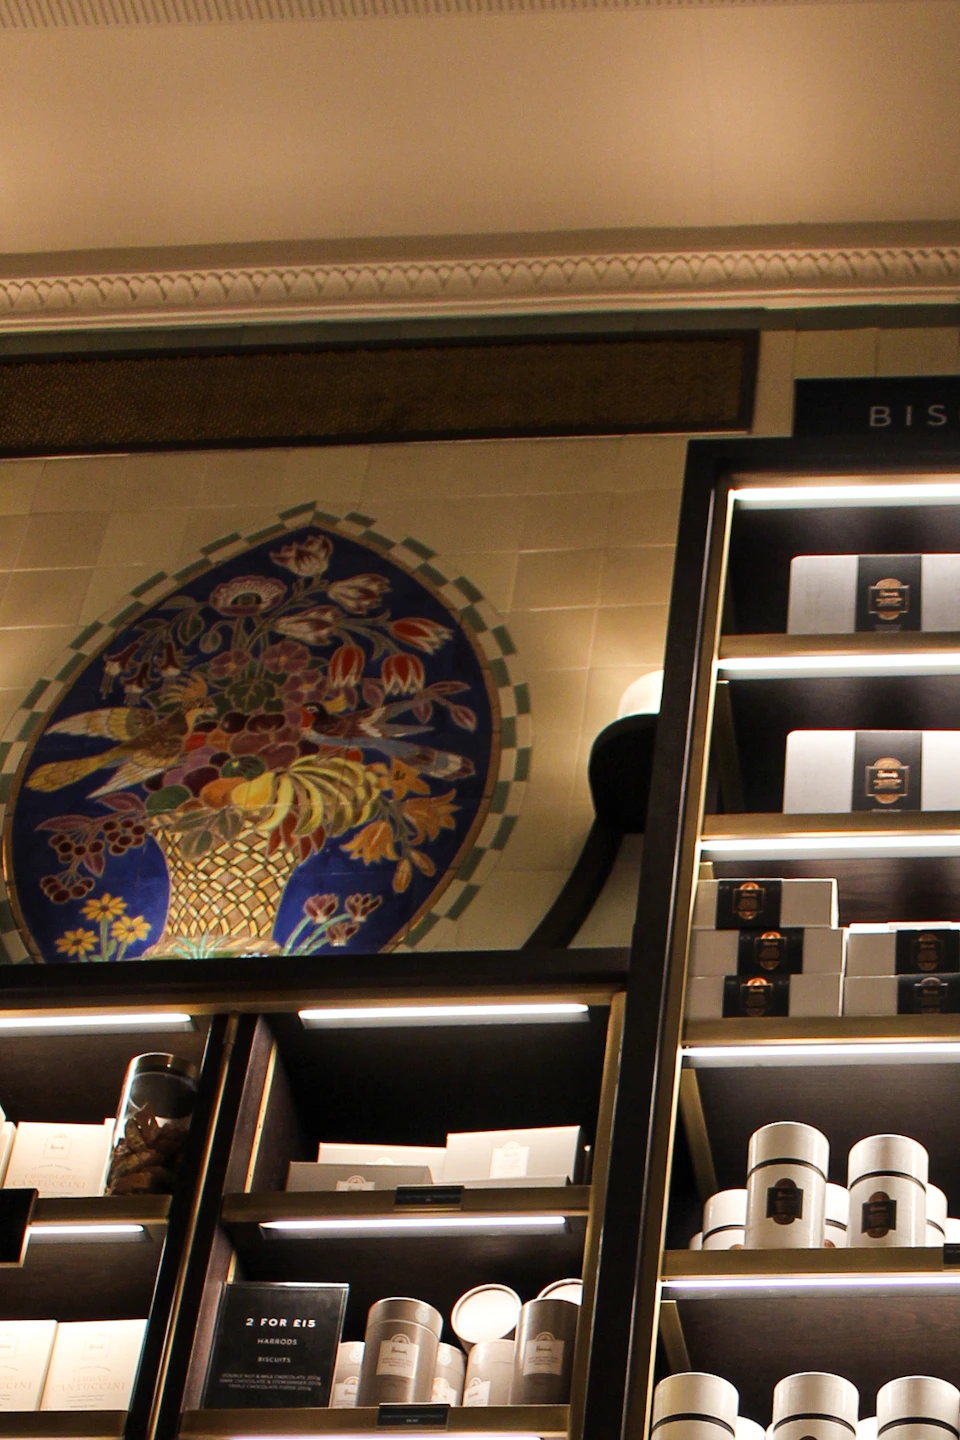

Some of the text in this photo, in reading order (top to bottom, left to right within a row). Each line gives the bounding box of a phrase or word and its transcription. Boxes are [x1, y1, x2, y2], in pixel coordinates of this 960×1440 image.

[246, 1317, 316, 1328] 2 FOR £15
